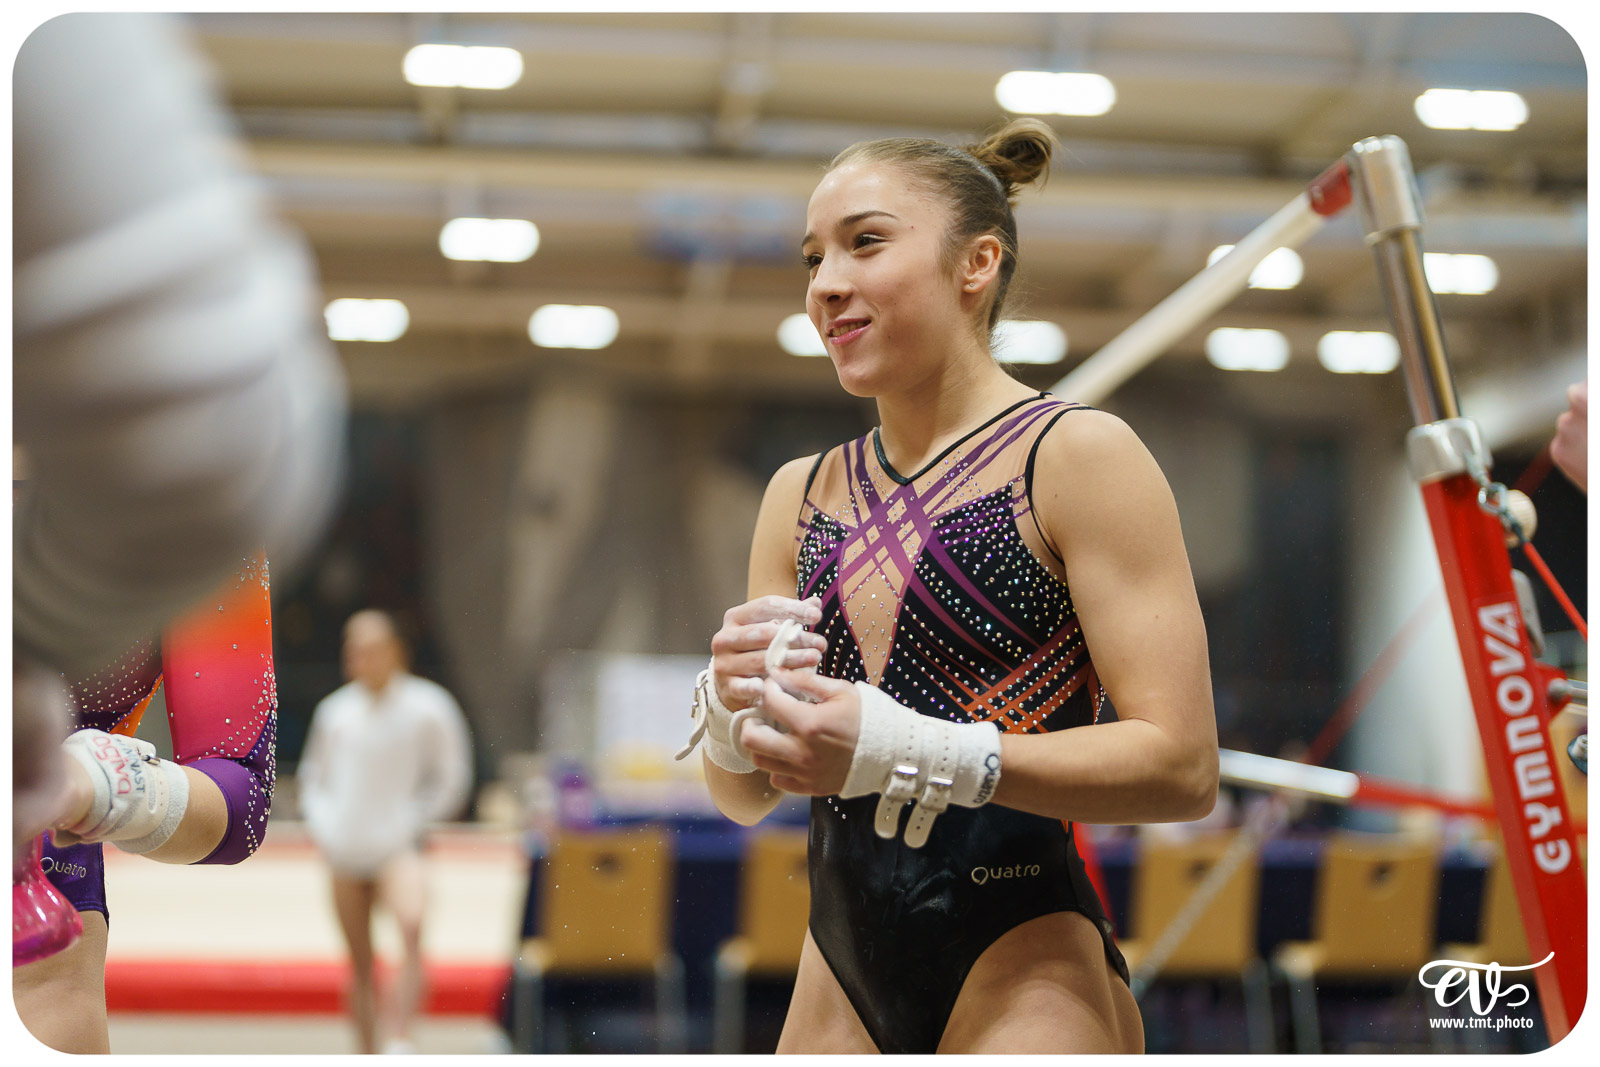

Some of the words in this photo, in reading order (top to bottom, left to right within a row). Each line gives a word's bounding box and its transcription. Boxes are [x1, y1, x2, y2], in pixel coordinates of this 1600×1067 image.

[1477, 601, 1572, 875] GYMNOVA
[40, 856, 87, 878] Quatro
[971, 864, 1041, 885] Quatro
